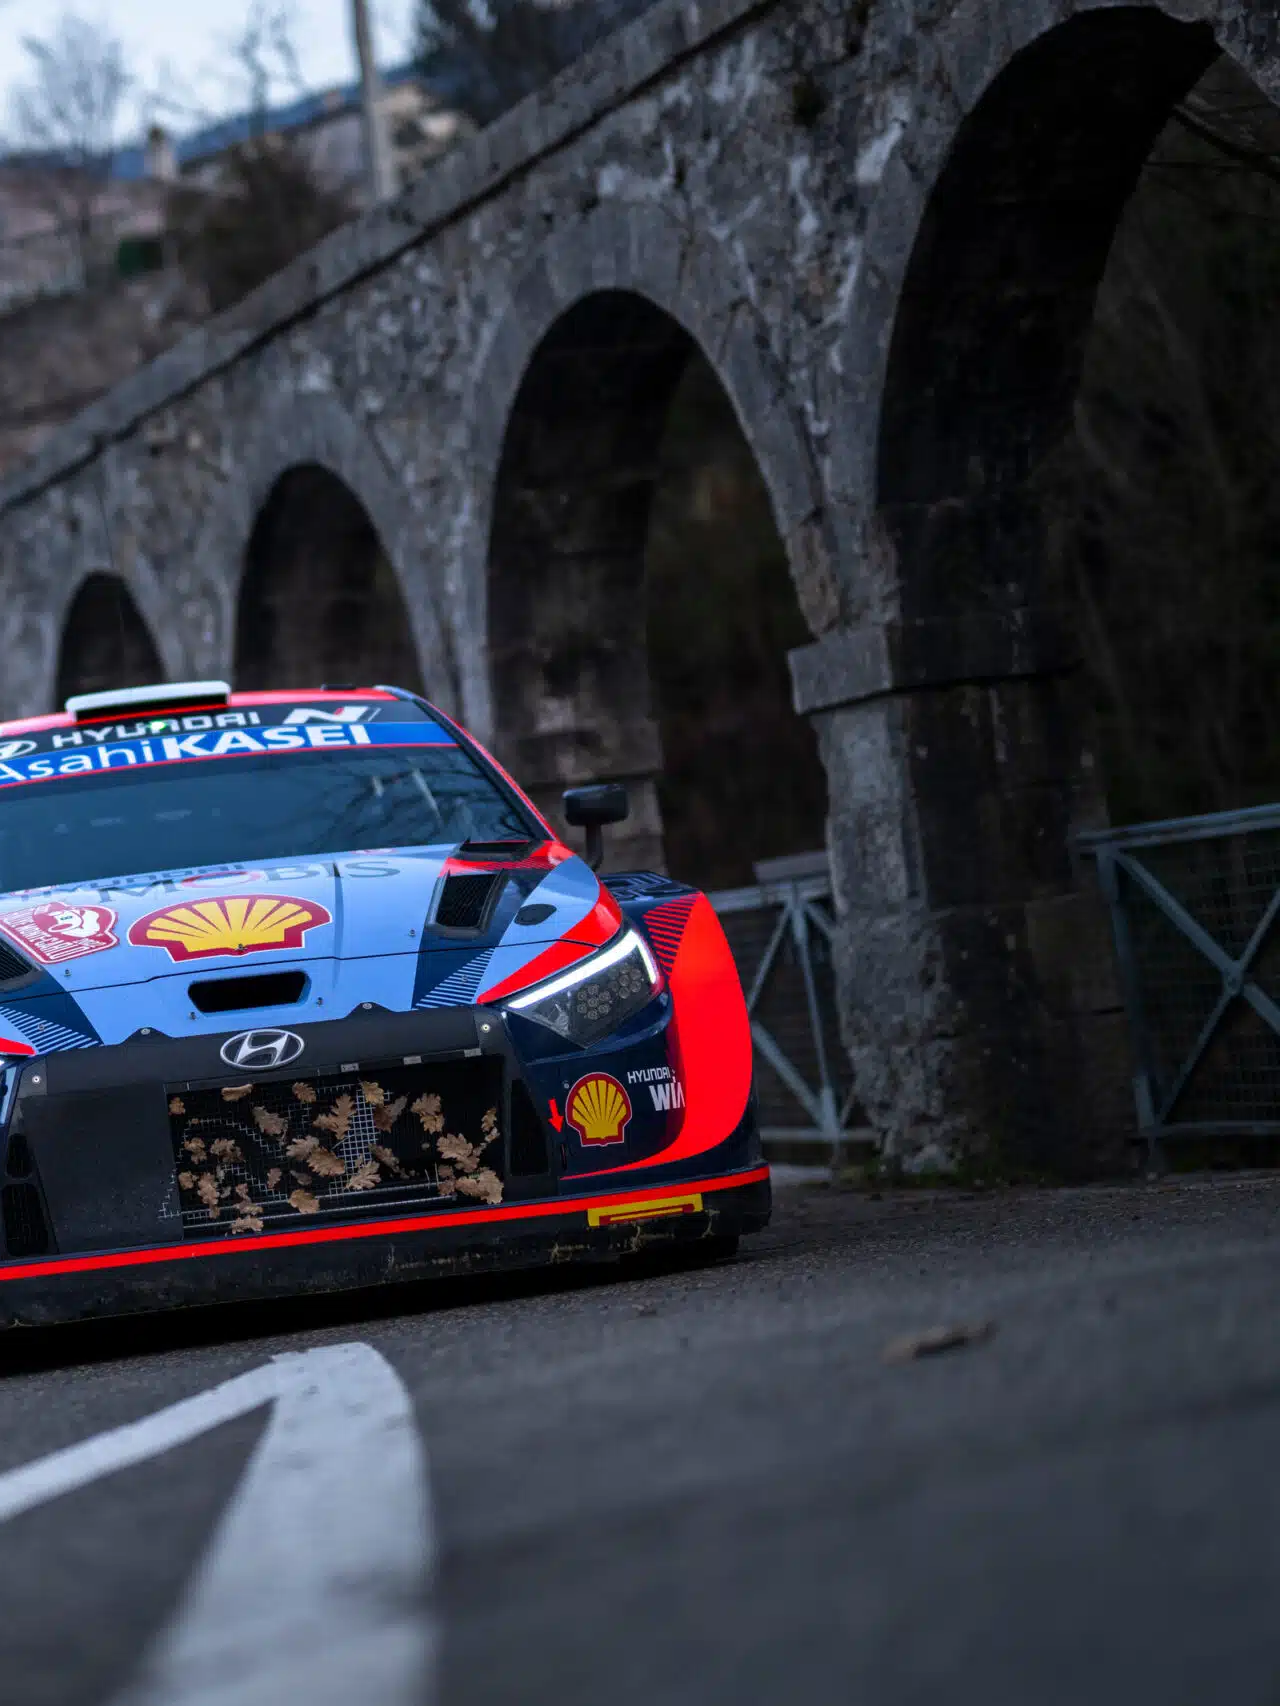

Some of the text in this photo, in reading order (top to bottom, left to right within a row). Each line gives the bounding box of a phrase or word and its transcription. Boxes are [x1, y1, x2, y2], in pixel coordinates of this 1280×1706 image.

[51, 711, 261, 748] HYUNDAI
[98, 860, 401, 902] MOBIS
[626, 1066, 671, 1084] HYUNDAI
